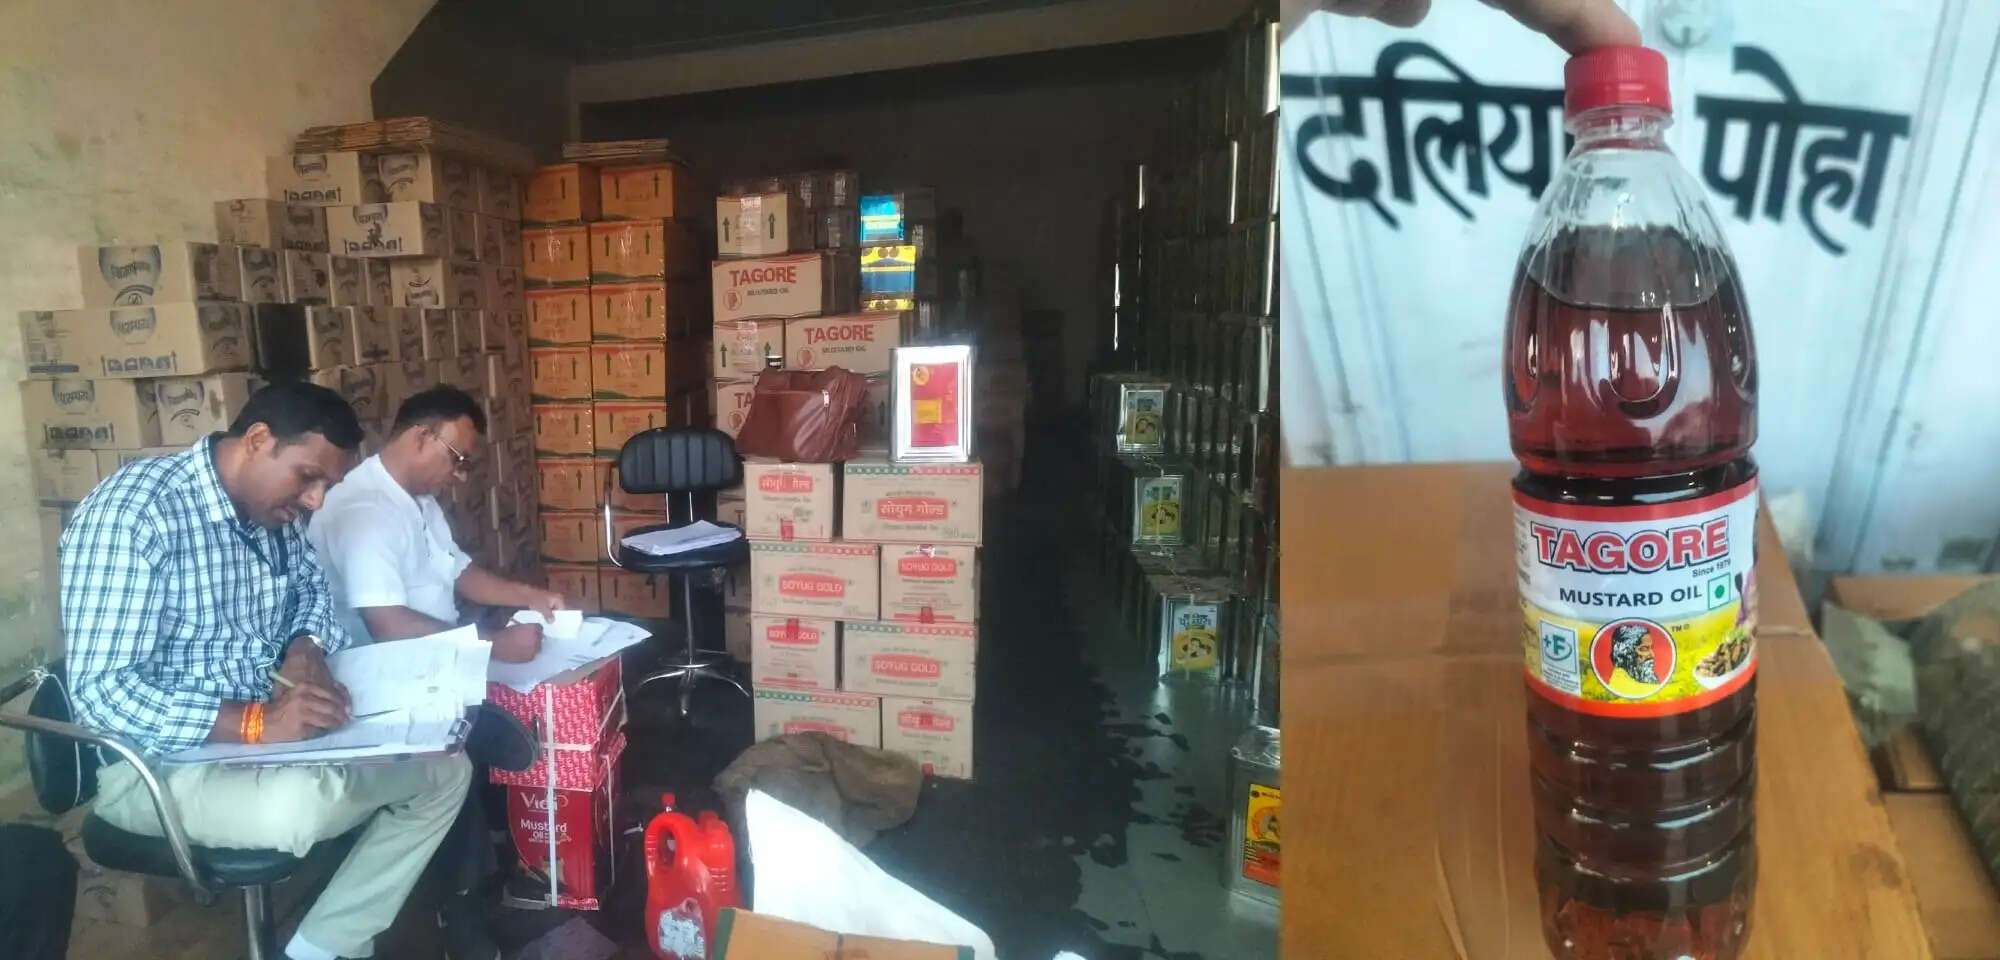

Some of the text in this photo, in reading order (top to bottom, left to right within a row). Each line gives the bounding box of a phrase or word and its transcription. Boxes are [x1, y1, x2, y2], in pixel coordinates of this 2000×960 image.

[1280, 41, 1910, 257] दलिय पोहा
[729, 265, 797, 287] TAGORE
[804, 323, 874, 344] TAGORE
[1531, 515, 1729, 575] TAGORE
[1692, 566, 1714, 578] Since
[782, 579, 843, 592] SOYUG GOLD
[1559, 585, 1703, 607] MUSTARD OIL
[874, 659, 937, 674] SOYUG GOLD
[520, 818, 568, 833] Mustrd
